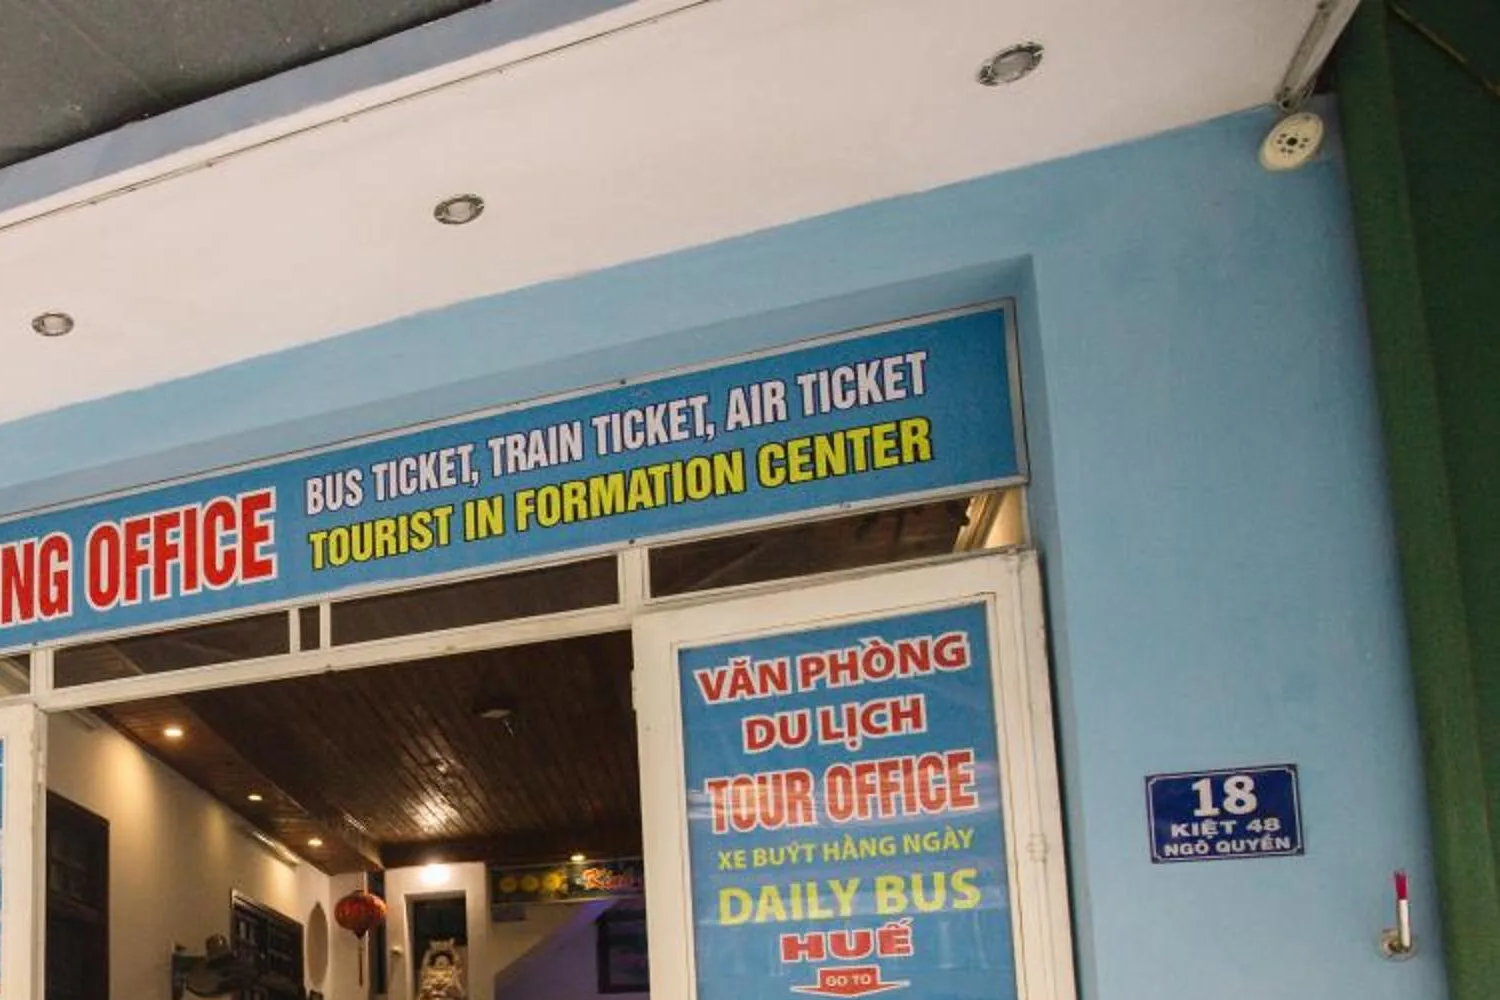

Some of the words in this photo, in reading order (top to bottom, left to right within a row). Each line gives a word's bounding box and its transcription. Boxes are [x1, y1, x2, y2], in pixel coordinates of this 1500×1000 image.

[306, 468, 363, 516] BUS
[372, 444, 481, 501] TICKET,
[487, 420, 583, 478] TRAIN
[592, 396, 716, 455] TICKET,
[725, 379, 787, 432] AIR
[797, 351, 928, 416] TICKET
[308, 505, 454, 570] TOURIST
[464, 495, 504, 541] IN
[515, 449, 746, 532] FORMATION
[757, 416, 933, 488] CENTER
[85, 486, 277, 611] OFFICE
[694, 656, 790, 705] VĂN
[798, 631, 970, 692] PHÒNG
[743, 711, 810, 754] DU
[818, 694, 927, 752] LỊCH
[704, 769, 816, 834] TOUR
[825, 749, 979, 823] OFFICE
[1191, 775, 1258, 817] 18
[718, 851, 747, 870] XE
[753, 842, 815, 868] BUÝT
[823, 833, 897, 861] HÀNG
[903, 825, 975, 854] NGÀY
[1170, 818, 1237, 839] KIỆT
[1245, 817, 1281, 833] 48
[718, 877, 861, 926] DAILY
[875, 868, 982, 915] BUS
[780, 917, 914, 963] HUẾ
[826, 976, 847, 987] GO
[852, 973, 871, 985] TO
